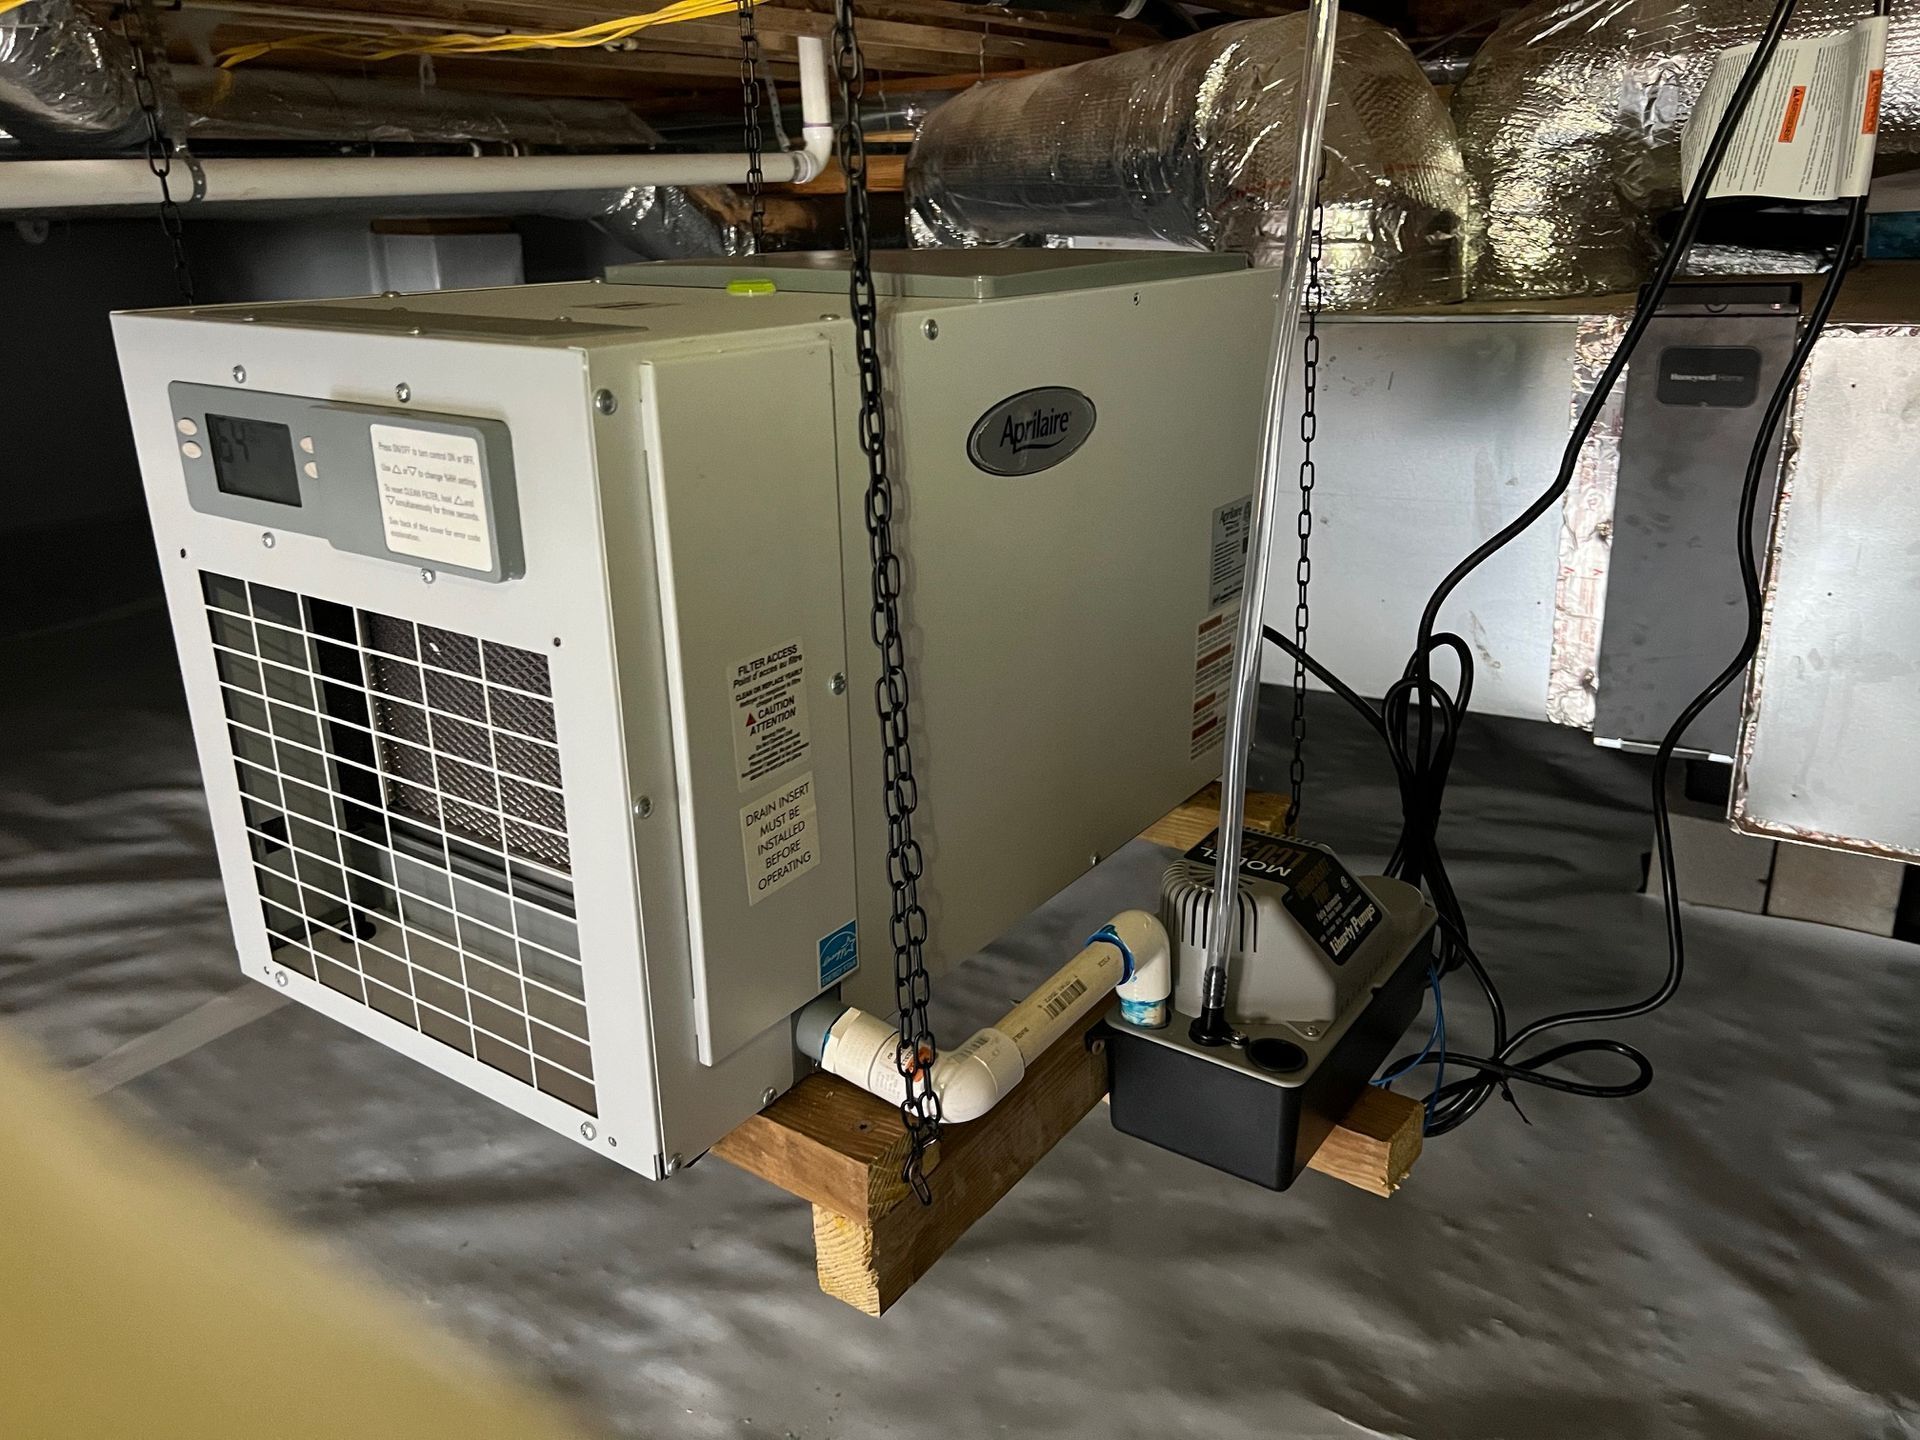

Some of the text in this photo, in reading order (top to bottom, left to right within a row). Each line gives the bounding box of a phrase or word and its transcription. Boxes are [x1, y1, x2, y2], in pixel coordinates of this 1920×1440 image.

[1000, 407, 1070, 453] Aprilaire
[738, 644, 798, 677] FILTER ACCESS
[749, 706, 797, 737] ATTENTION
[757, 695, 795, 719] CAUTION
[745, 781, 810, 828] DRAIN INSERT
[759, 804, 801, 837] MUST BE
[757, 819, 806, 856] INSTALLED
[764, 838, 802, 870] BEFORE
[757, 850, 812, 891] OPERATING
[1329, 924, 1356, 956] Liberty
[1350, 903, 1376, 933] Pumps
